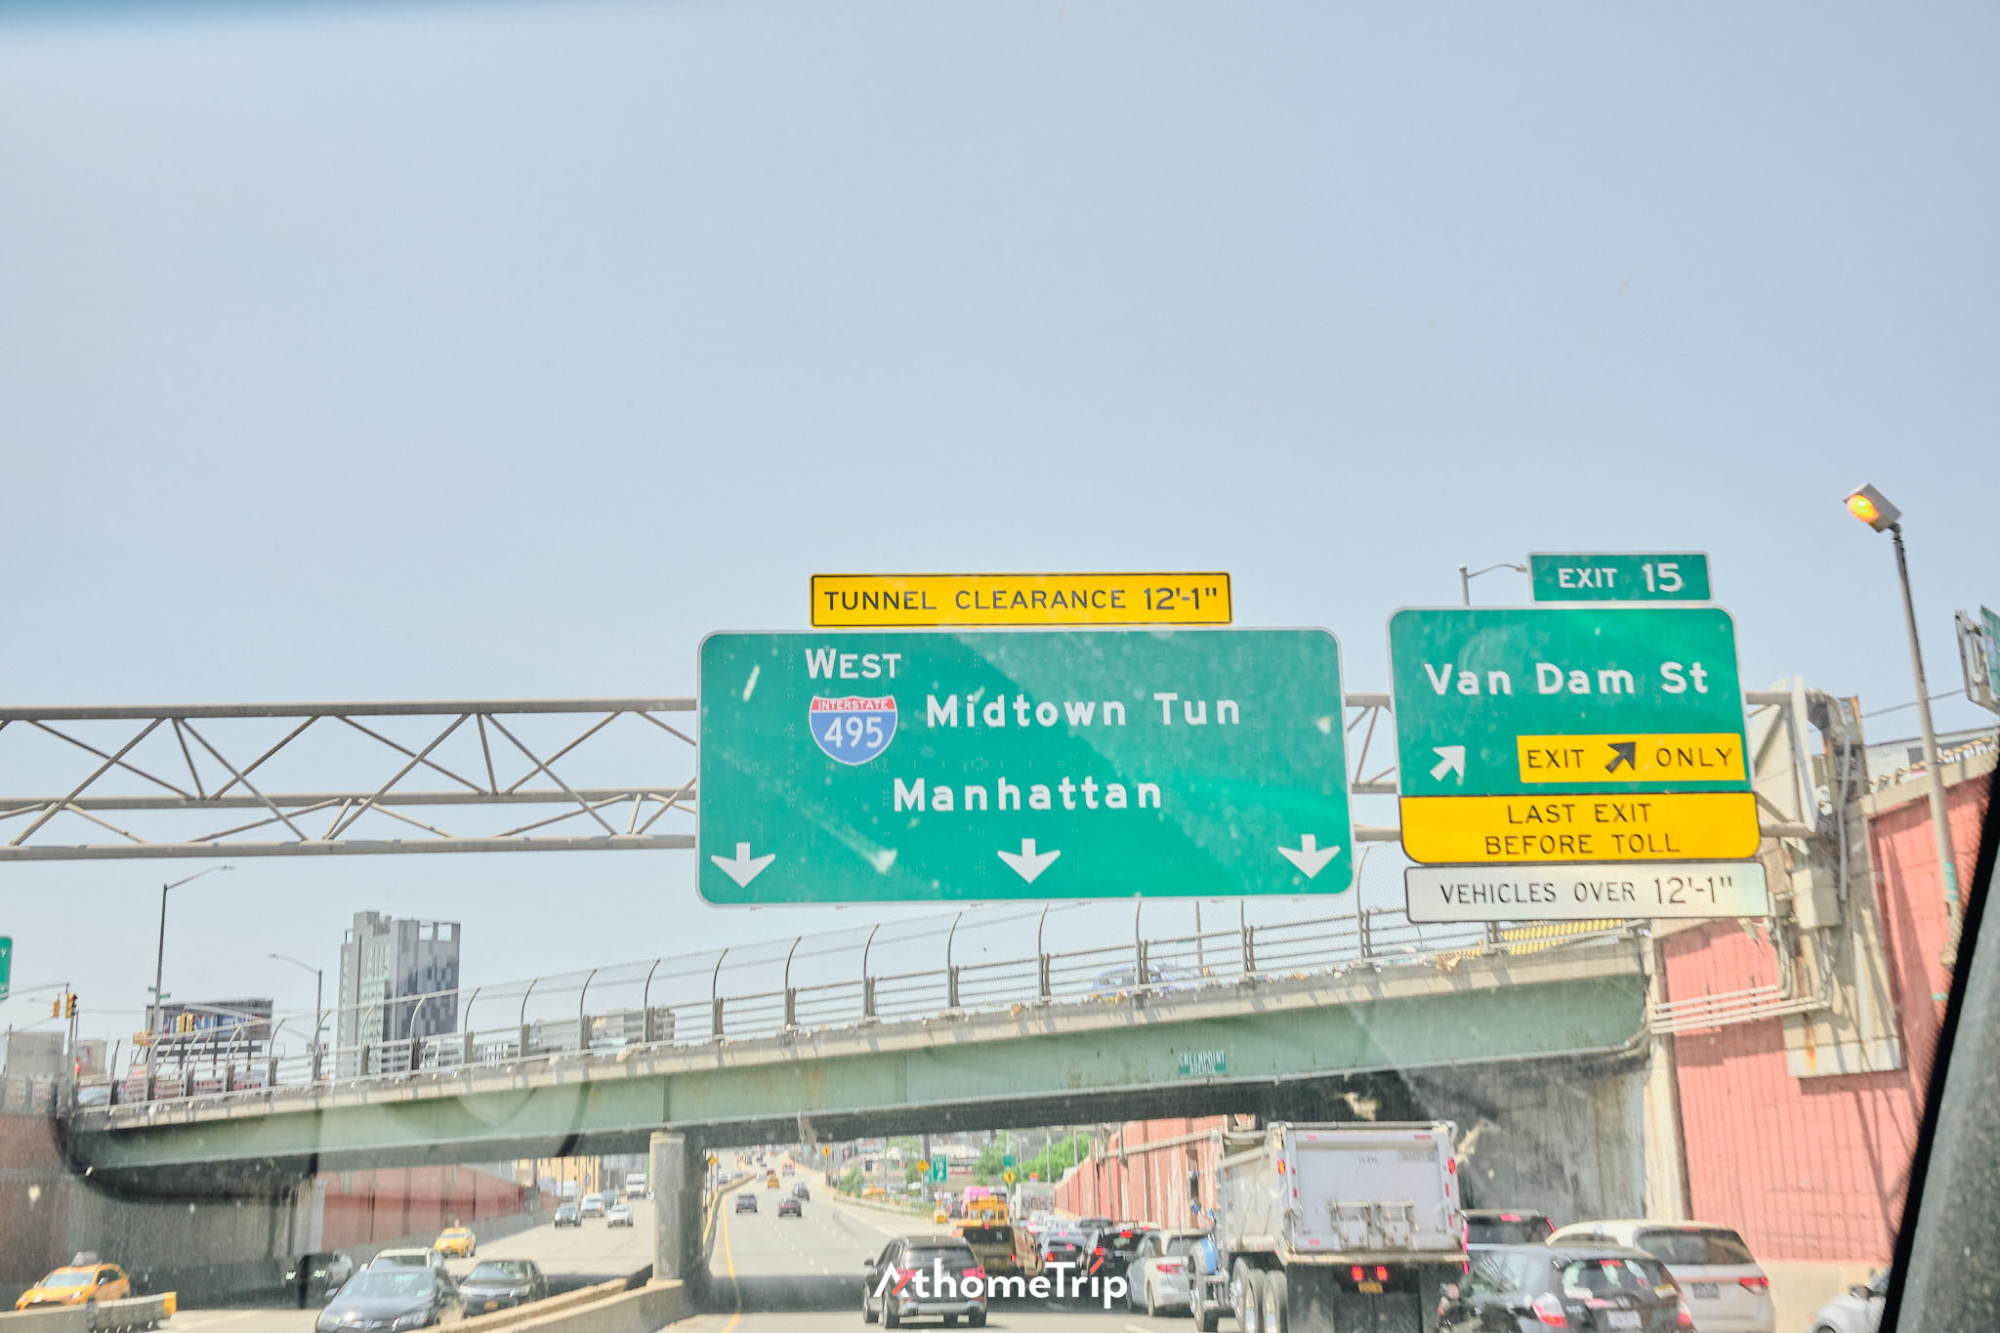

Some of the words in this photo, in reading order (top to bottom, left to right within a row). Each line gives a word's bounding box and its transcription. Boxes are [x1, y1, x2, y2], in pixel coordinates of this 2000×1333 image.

[1558, 568, 1617, 588] EXIT
[1642, 564, 1683, 592] 15
[823, 591, 936, 611] TUNNEL
[955, 590, 1126, 610] CLEARANCE
[1143, 587, 1218, 611] 12'-1"
[805, 648, 901, 680] WEST
[1424, 663, 1512, 695] Van
[1536, 662, 1634, 694] Dam
[1661, 661, 1708, 694] St
[818, 700, 888, 710] INTERSTATE
[927, 694, 1125, 728] Midtown
[1154, 692, 1240, 725] Tun
[824, 716, 883, 748] 495
[1528, 750, 1584, 768] EXIT
[1656, 748, 1732, 767] ONLY
[894, 777, 1161, 812] Manhattan
[1507, 804, 1575, 825] LAST
[1594, 804, 1652, 824] EXIT
[1486, 834, 1593, 855] BEFORE
[1612, 833, 1680, 853] TOLL
[1441, 883, 1557, 905] VEHICLES
[1574, 882, 1635, 903] OVER
